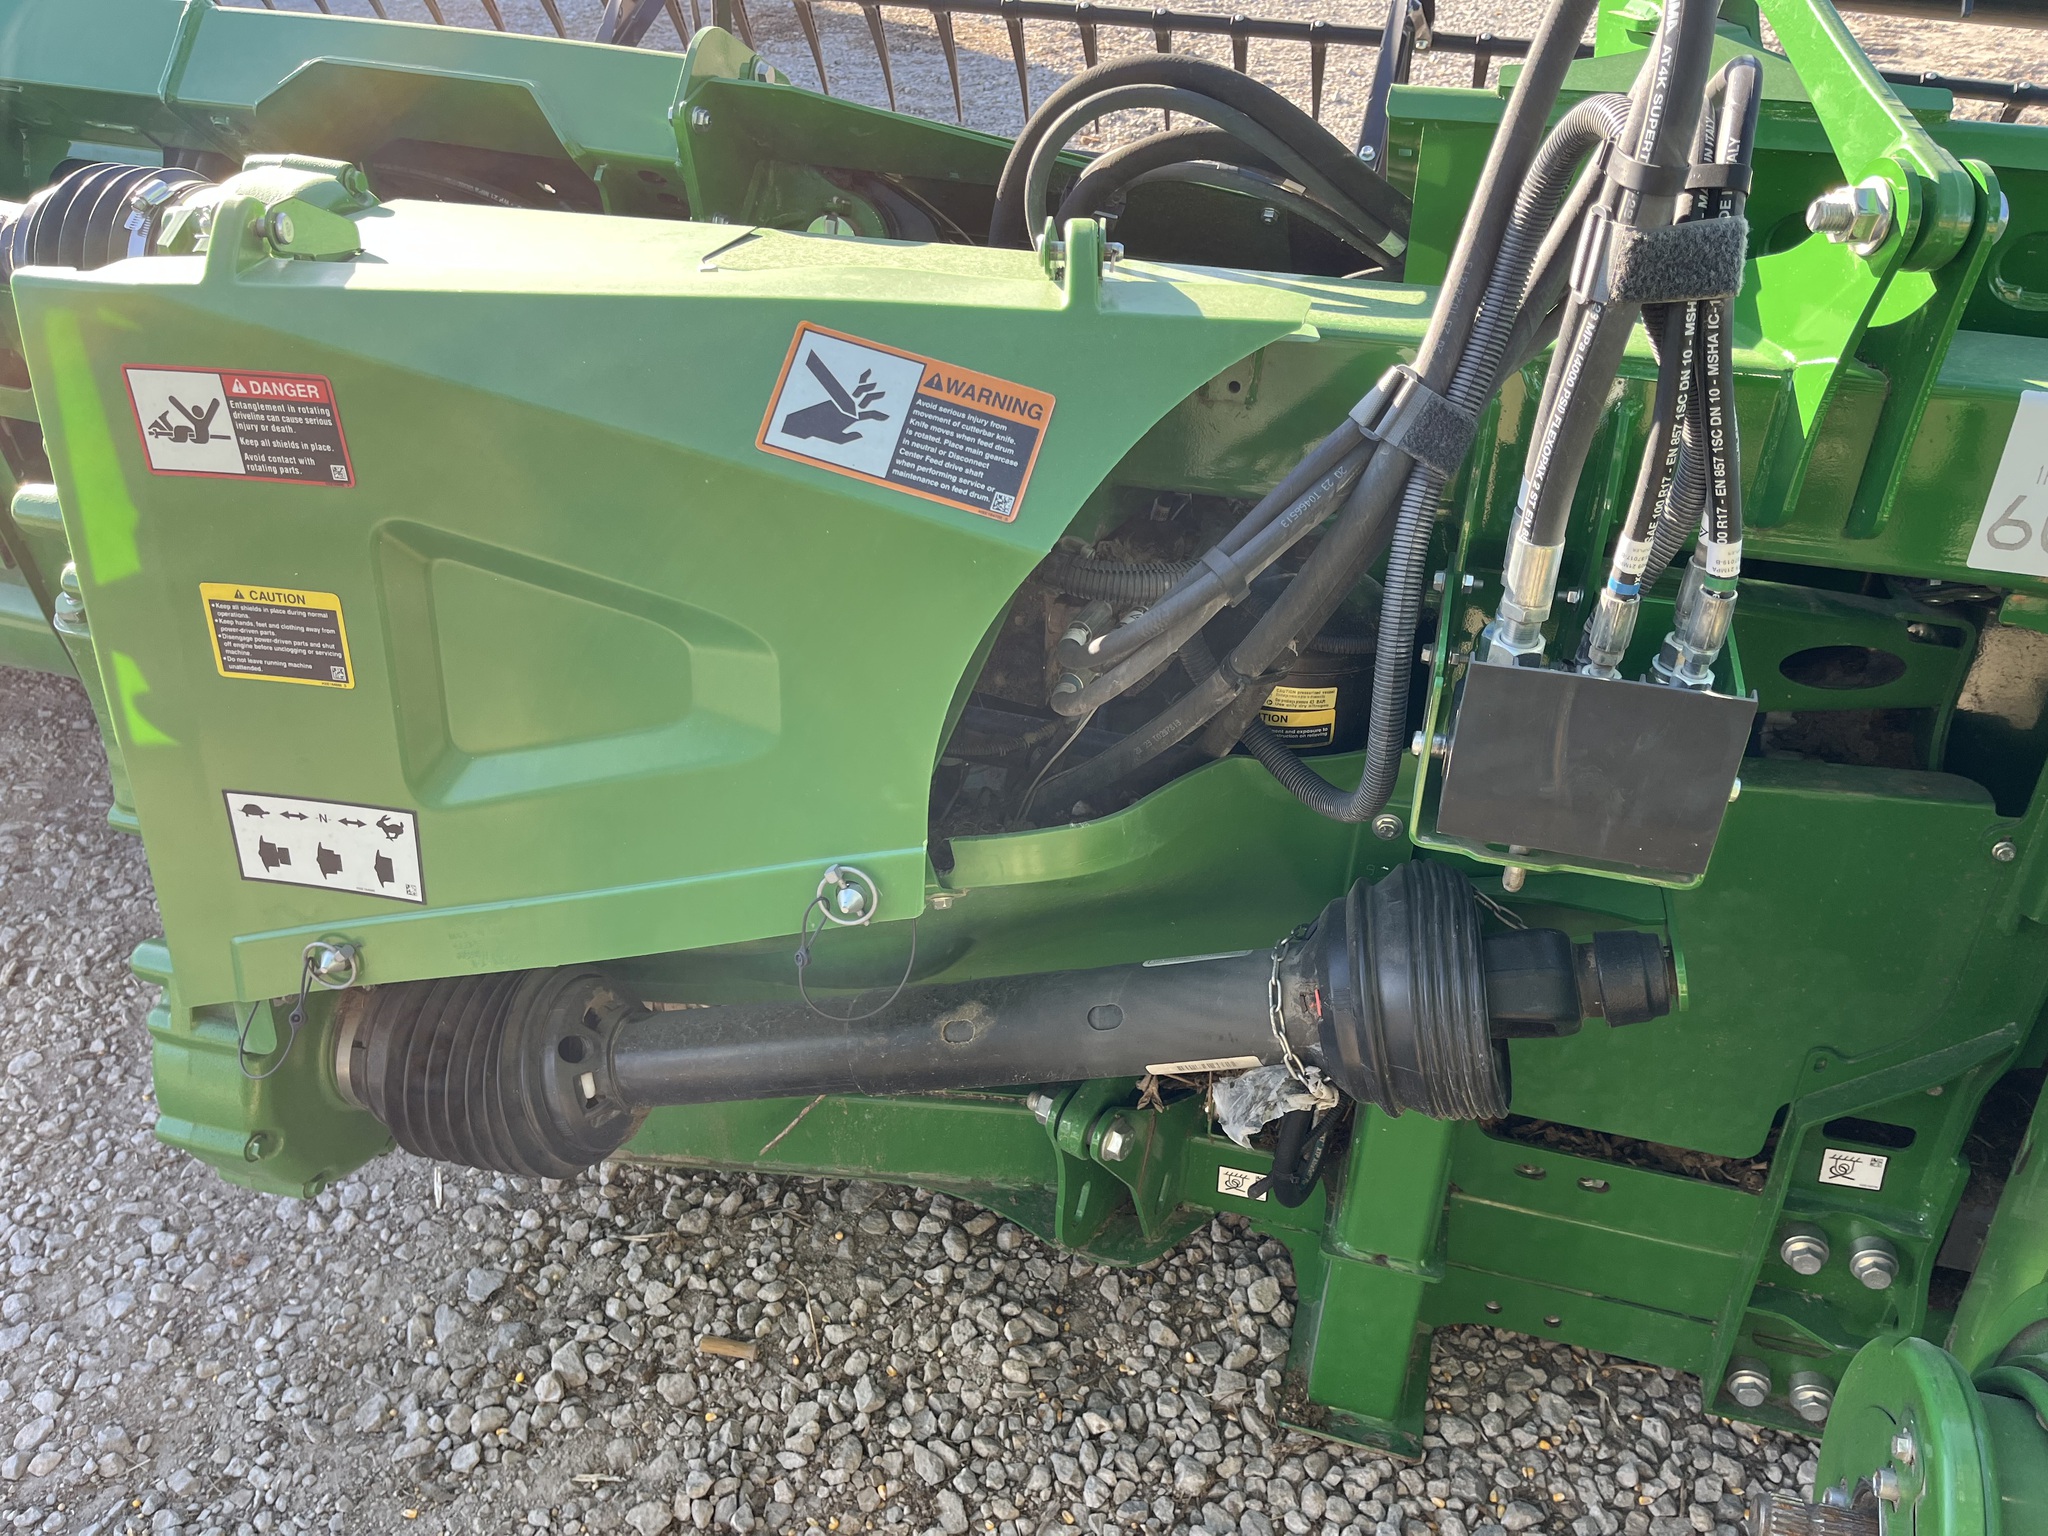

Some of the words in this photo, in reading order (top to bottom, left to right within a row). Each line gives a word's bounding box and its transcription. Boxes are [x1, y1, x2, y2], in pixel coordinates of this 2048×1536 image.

[1655, 44, 1672, 88] AT4K
[1703, 116, 1714, 145] ITALY
[1703, 148, 1712, 162] IN
[1588, 303, 1601, 319] 28
[1578, 321, 1594, 350] MPa
[1682, 349, 1692, 365] 10
[1707, 333, 1718, 375] MSHA
[1565, 353, 1583, 387] (4000
[1679, 369, 1690, 390] DN
[249, 380, 318, 397] DANGER
[946, 377, 1042, 419] WARNING
[1708, 388, 1720, 402] 10
[229, 400, 285, 411] Entanglement
[287, 404, 295, 412] in
[297, 406, 330, 416] rotating
[1556, 388, 1570, 412] PSI)
[1675, 393, 1687, 419] 1SC
[232, 411, 264, 420] driveline
[281, 415, 303, 423] cause
[304, 417, 332, 425] serious
[915, 398, 937, 410] Avoid
[938, 406, 965, 418] serious
[967, 413, 988, 426] injury
[989, 420, 1007, 431] from
[1710, 406, 1721, 425] DN
[235, 421, 258, 432] injury
[270, 424, 295, 433] death.
[909, 418, 928, 429] Knife
[929, 425, 954, 436] moves
[956, 433, 975, 443] when
[977, 438, 993, 448] feed
[994, 444, 1014, 454] drum
[912, 409, 951, 424] movement
[961, 423, 994, 437] cutterbar
[995, 433, 1015, 444] knife.
[1670, 424, 1682, 444] 857
[239, 436, 258, 447] Keep
[260, 438, 270, 446] all
[272, 439, 299, 449] shields
[300, 441, 308, 449] in
[310, 442, 334, 451] place.
[905, 427, 912, 435] is
[914, 431, 941, 443] rotated.
[943, 438, 963, 450] Place
[964, 446, 983, 456] main
[984, 452, 1018, 466] gearcase
[1535, 414, 1560, 480] FLEXOPAK
[1711, 429, 1723, 451] 1SC
[244, 452, 265, 461] Avoid
[267, 455, 296, 463] contact
[297, 456, 315, 465] with
[902, 437, 909, 445] in
[911, 441, 937, 453] neutral
[948, 451, 989, 468] Disconnect
[1665, 447, 1678, 464] EN
[246, 463, 277, 474] rotating
[279, 466, 302, 474] parts.
[899, 447, 923, 459] Center
[924, 455, 943, 466] Feed
[944, 461, 963, 472] drive
[964, 468, 983, 478] shaft
[1713, 457, 1724, 476] 857
[895, 458, 915, 468] when
[916, 465, 957, 482] performing
[958, 477, 985, 489] service
[892, 469, 938, 486] maintenance
[940, 482, 950, 490] on
[951, 485, 968, 495] feed
[968, 491, 990, 502] drum.
[1320, 478, 1333, 490] 23
[1532, 479, 1540, 489] 2
[1657, 476, 1670, 498] R17
[1716, 479, 1726, 496] EN
[1528, 490, 1537, 507] ST
[1522, 508, 1533, 527] EN
[1652, 500, 1664, 518] 100
[1717, 507, 1727, 528] R17
[1644, 521, 1658, 543] SAE
[249, 589, 306, 605] CAUTION
[215, 602, 230, 610] Keep
[286, 609, 306, 617] during
[220, 626, 258, 634] power-driven
[221, 633, 252, 642] Disengage
[280, 624, 304, 632] clothing
[273, 646, 306, 655] unclogging
[315, 650, 342, 658] servicing
[263, 660, 286, 668] running
